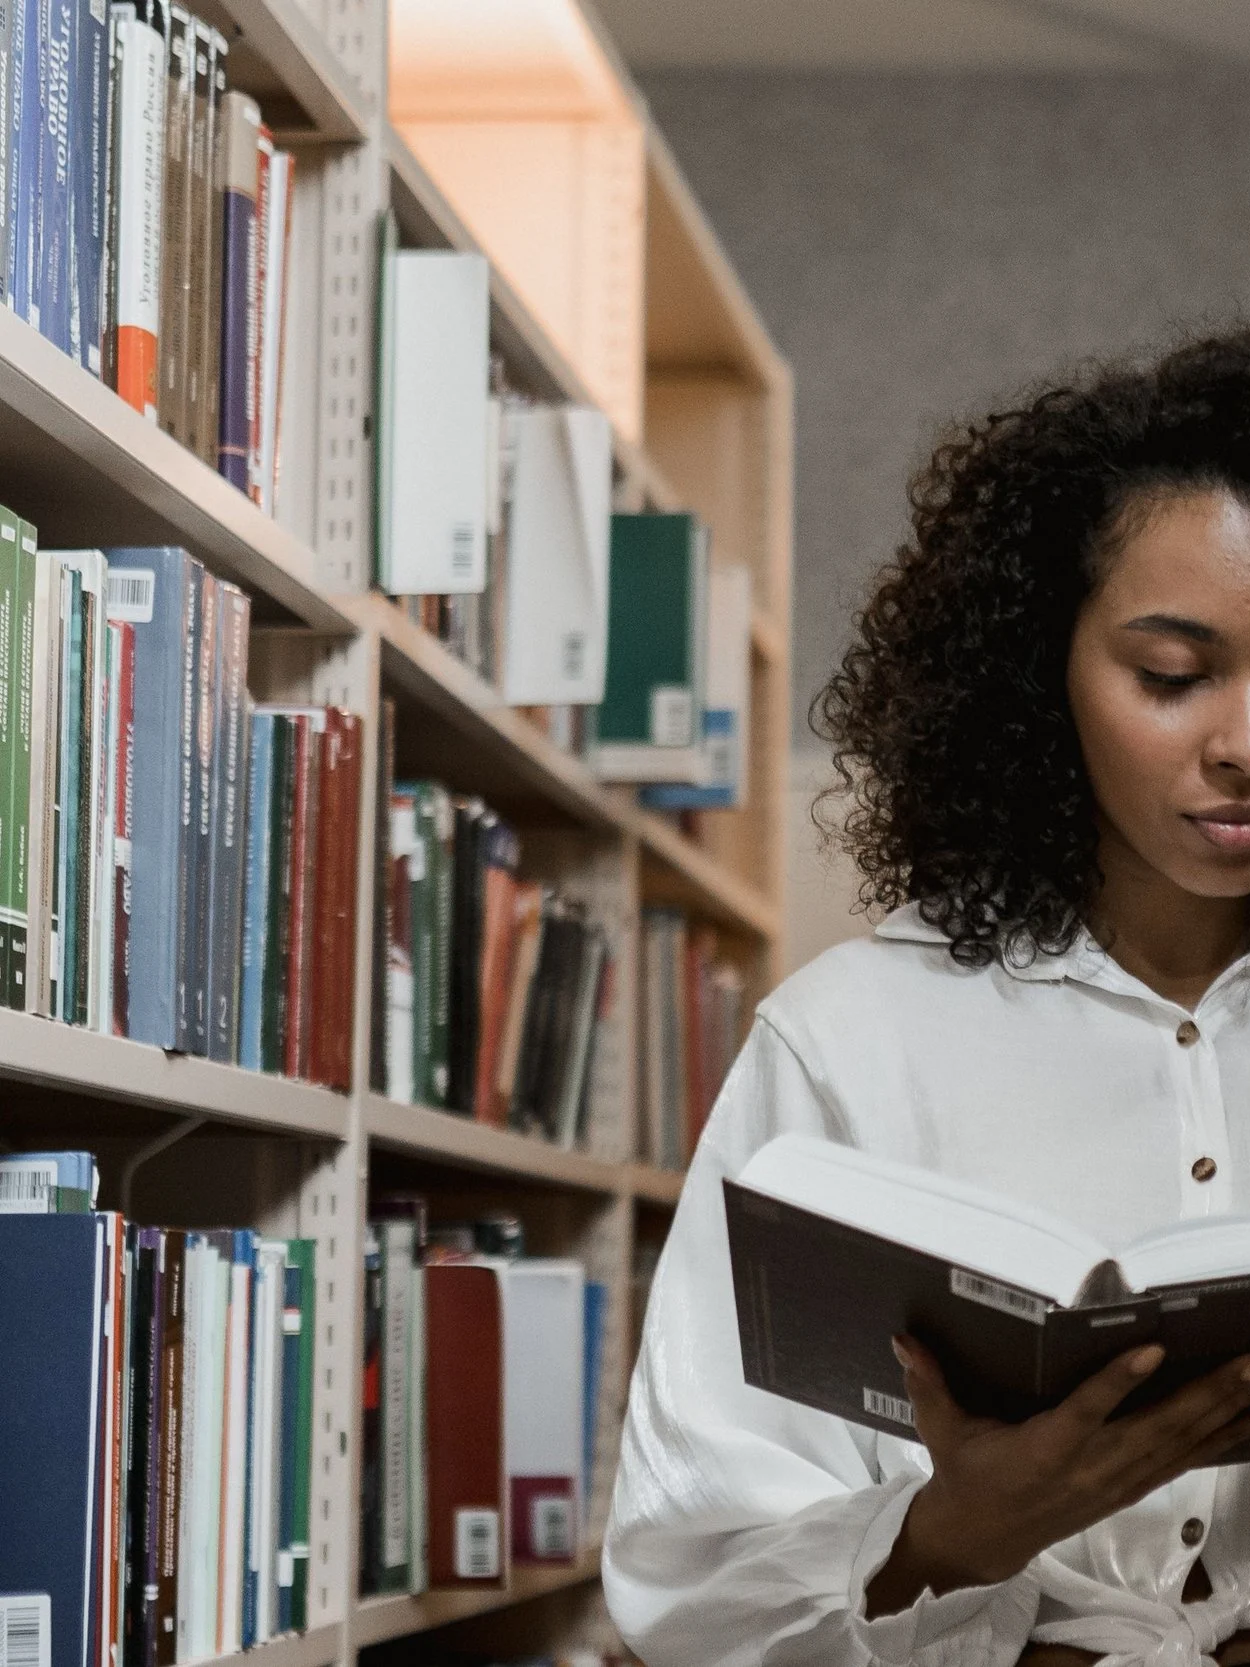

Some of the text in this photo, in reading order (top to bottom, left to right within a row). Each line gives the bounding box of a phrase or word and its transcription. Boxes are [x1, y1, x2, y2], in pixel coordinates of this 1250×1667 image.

[0, 50, 8, 160] Уголовное
[48, 38, 60, 137] ПРАВО
[56, 5, 71, 187] УГОЛОВНОЕ
[139, 51, 155, 304] Уголовное право России
[123, 722, 134, 915] УГОЛОВНОЕ ПРАВО
